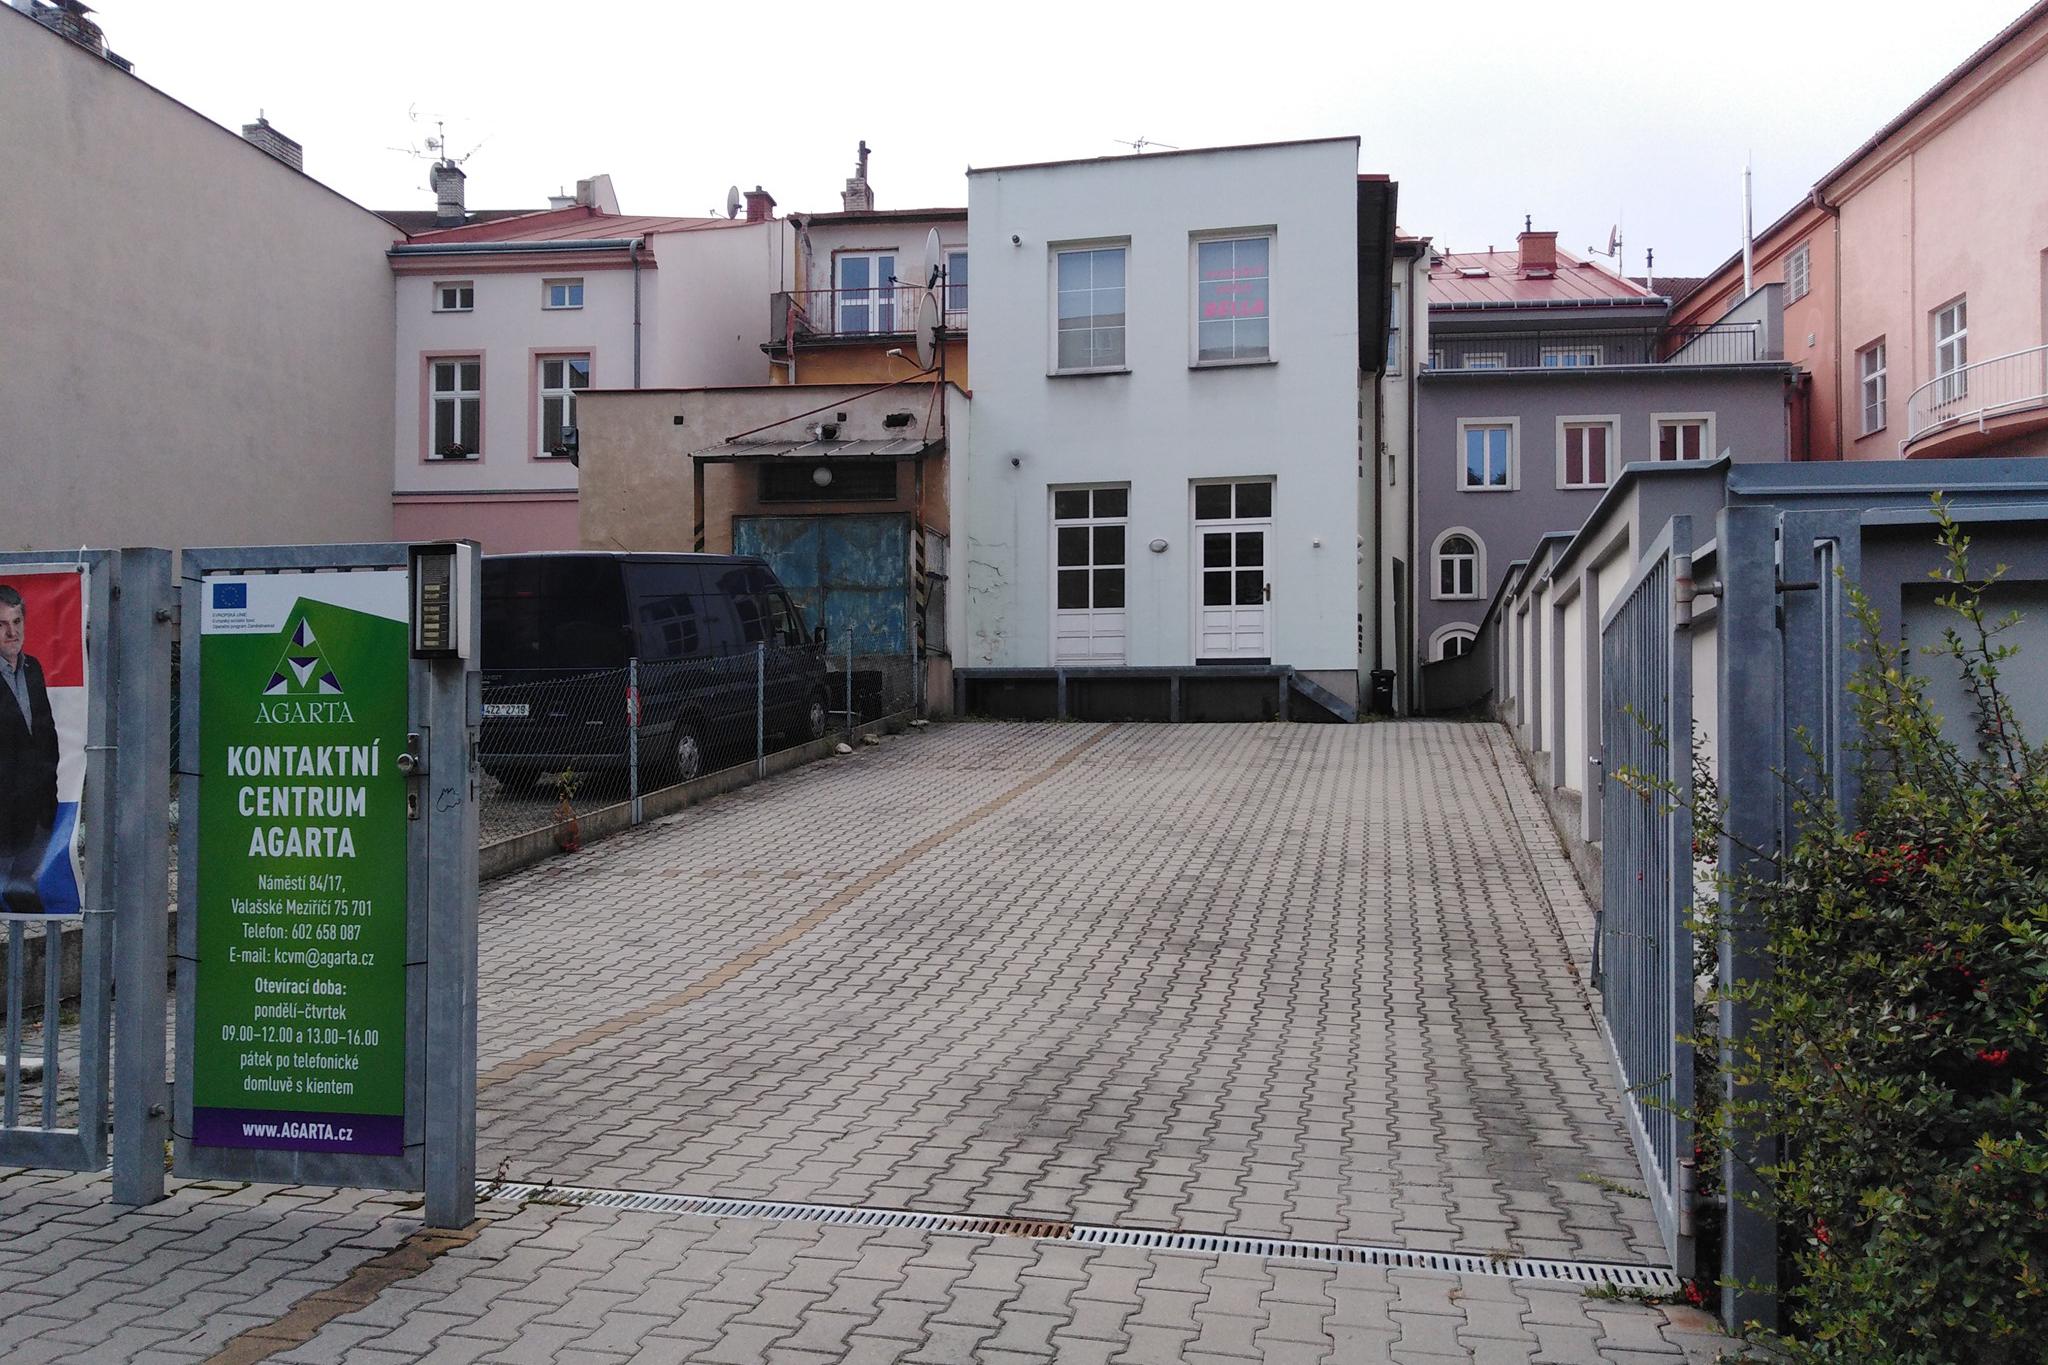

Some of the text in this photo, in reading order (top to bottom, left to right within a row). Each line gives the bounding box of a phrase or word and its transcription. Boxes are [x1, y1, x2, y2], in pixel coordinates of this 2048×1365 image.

[254, 702, 355, 724] AGARTA
[227, 738, 380, 777] KONTAKTNÍ
[238, 786, 366, 817] CENTRUM
[248, 826, 357, 858] AGARTA
[258, 873, 346, 893] Náměstí 84/17,
[231, 898, 372, 916] Valašské Meziříčí 75 701
[242, 923, 361, 941] Telefon: 602 658 087
[229, 947, 374, 969] E-mail: kcvm@agarta.cz
[254, 977, 347, 996] Otevírací doba:
[296, 1032, 303, 1043] a
[240, 1051, 359, 1071] pátek po telefonické
[243, 1075, 354, 1095] domluvě s kientem
[242, 1122, 353, 1141] www.AGARTA.cz
